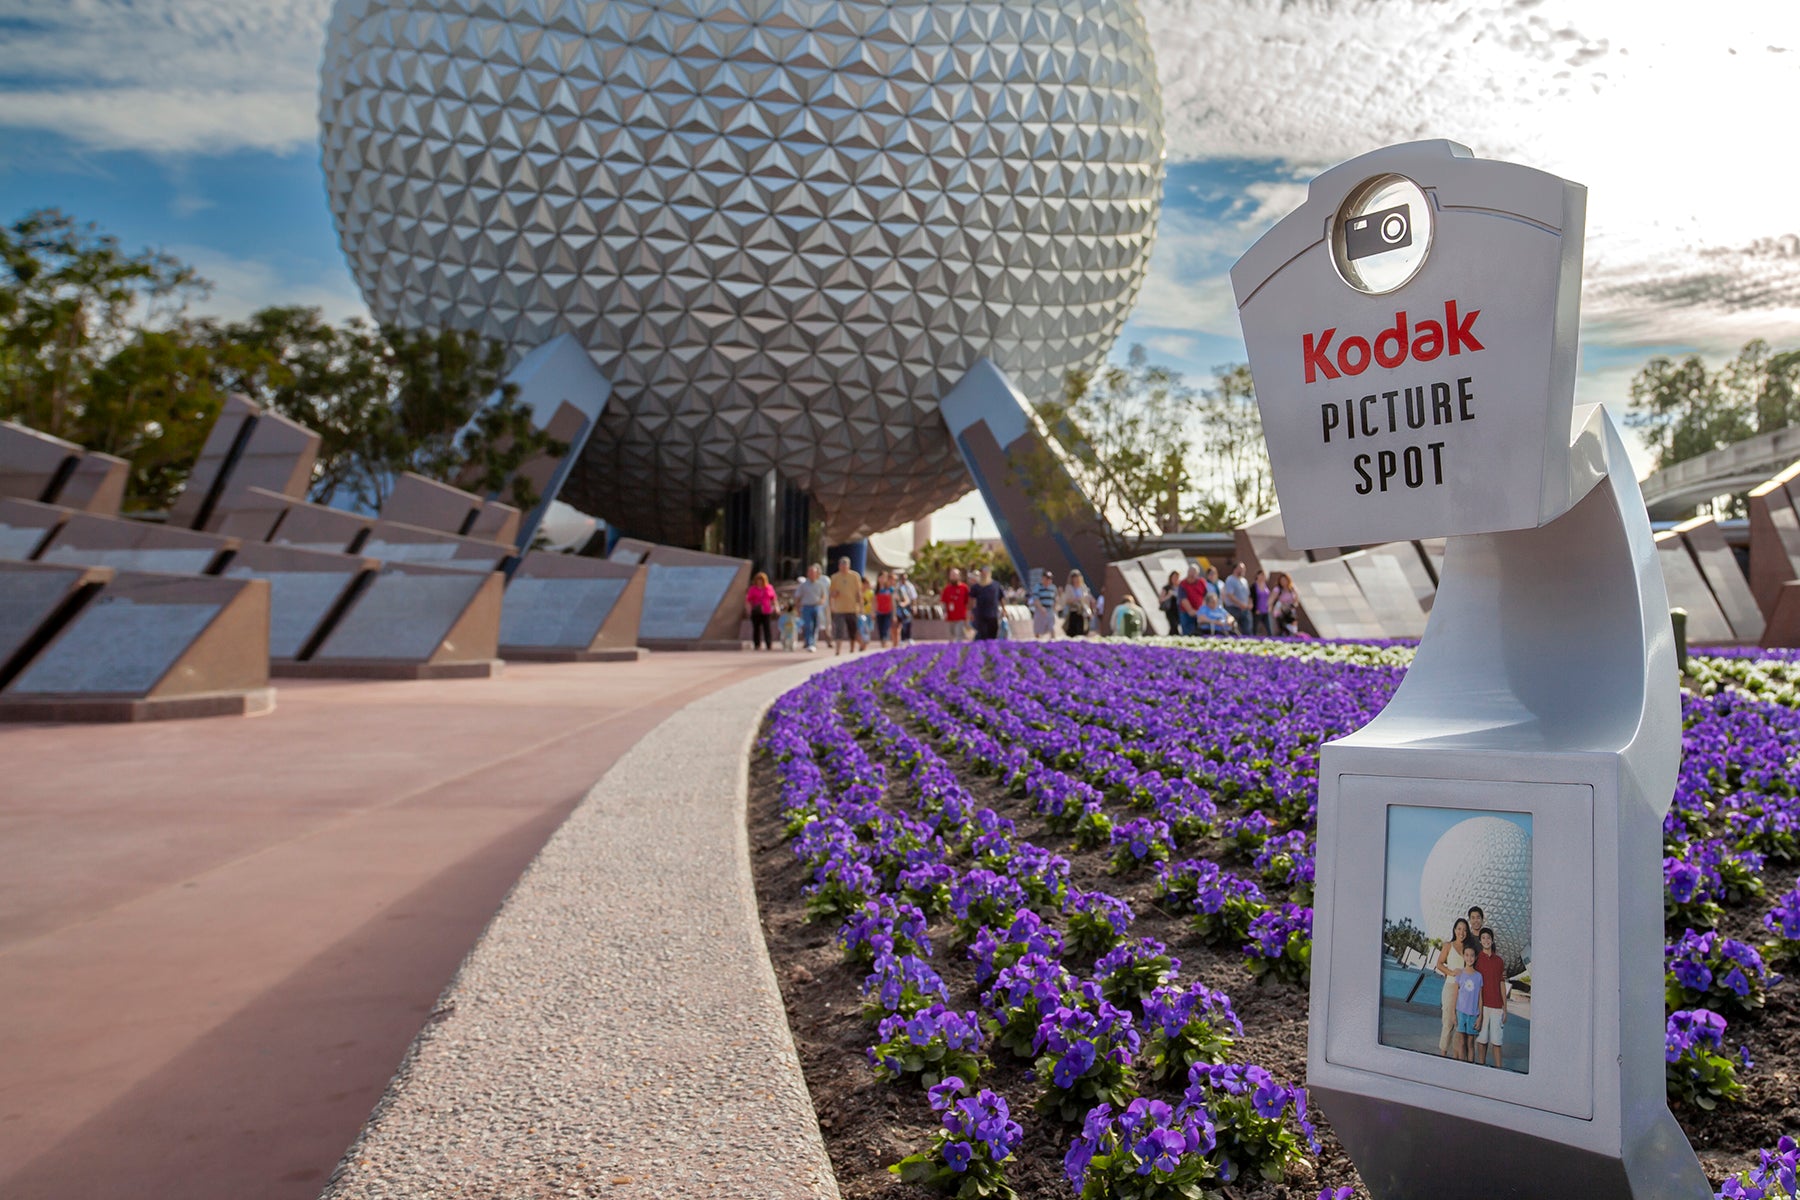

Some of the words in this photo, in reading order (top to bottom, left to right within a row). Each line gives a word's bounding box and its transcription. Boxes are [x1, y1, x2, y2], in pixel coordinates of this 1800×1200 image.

[1302, 299, 1485, 384] Kodak
[1321, 376, 1476, 444] PICTURE
[1353, 441, 1446, 496] SPOT
